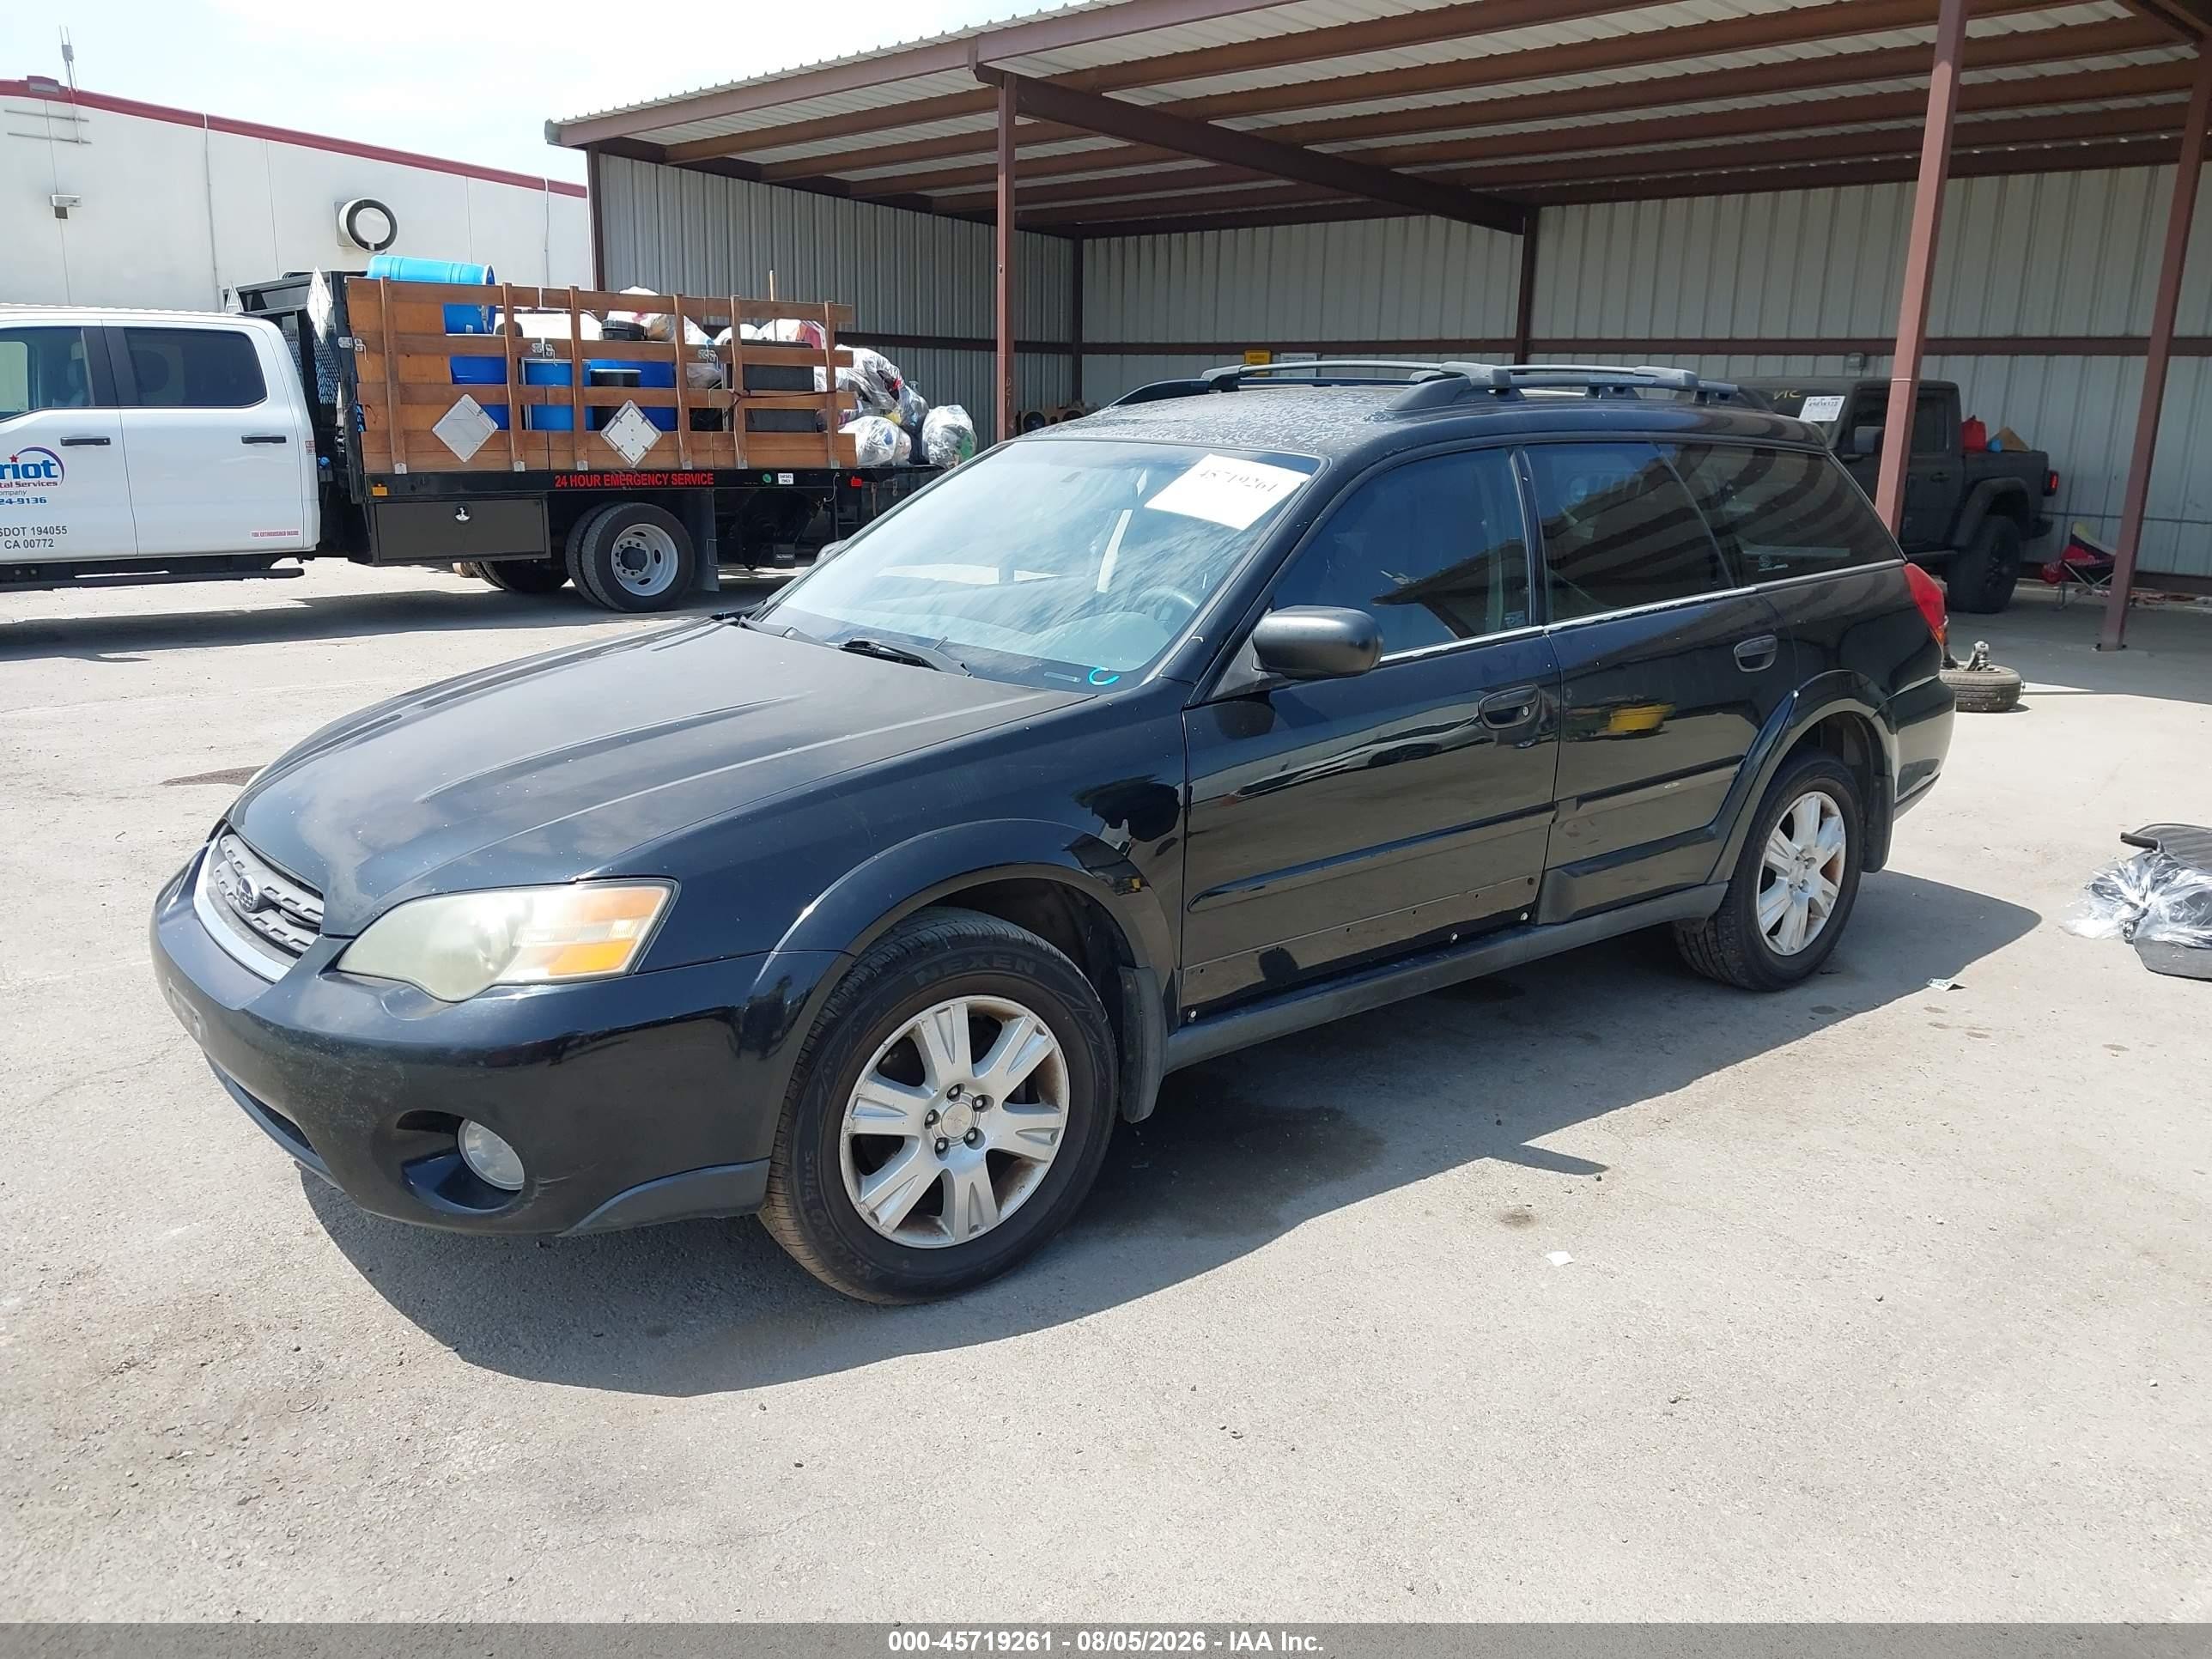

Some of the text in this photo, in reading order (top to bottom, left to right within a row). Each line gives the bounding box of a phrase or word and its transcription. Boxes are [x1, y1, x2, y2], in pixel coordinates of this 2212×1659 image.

[555, 472, 714, 488] 24 HOUR EMERGENCY SERVICE
[31, 525, 68, 536] 194055
[4, 538, 54, 549] CA 00772
[915, 954, 1036, 987] NEXEN
